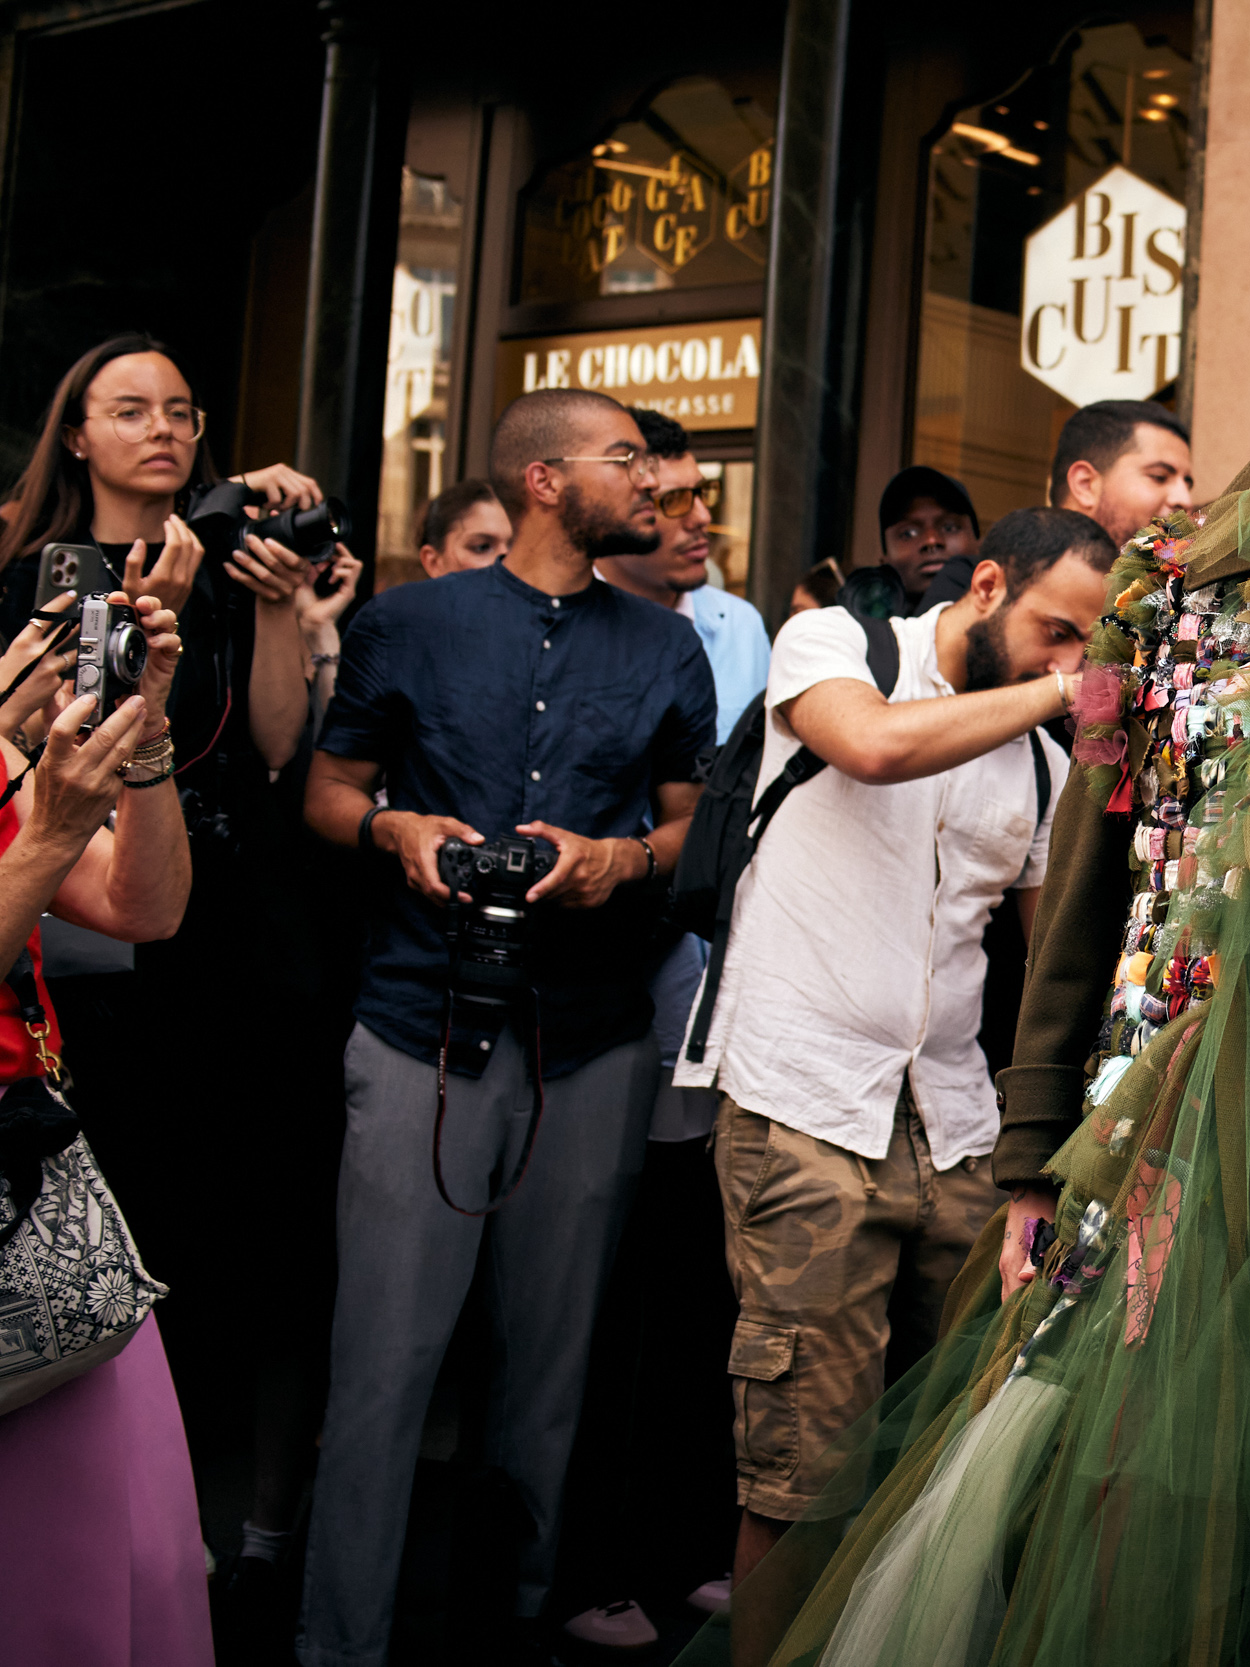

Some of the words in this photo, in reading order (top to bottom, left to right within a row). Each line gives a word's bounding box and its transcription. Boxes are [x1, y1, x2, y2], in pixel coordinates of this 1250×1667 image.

[1070, 192, 1183, 297] BIS
[523, 349, 571, 393] LE
[577, 333, 761, 389] CHOCOLA
